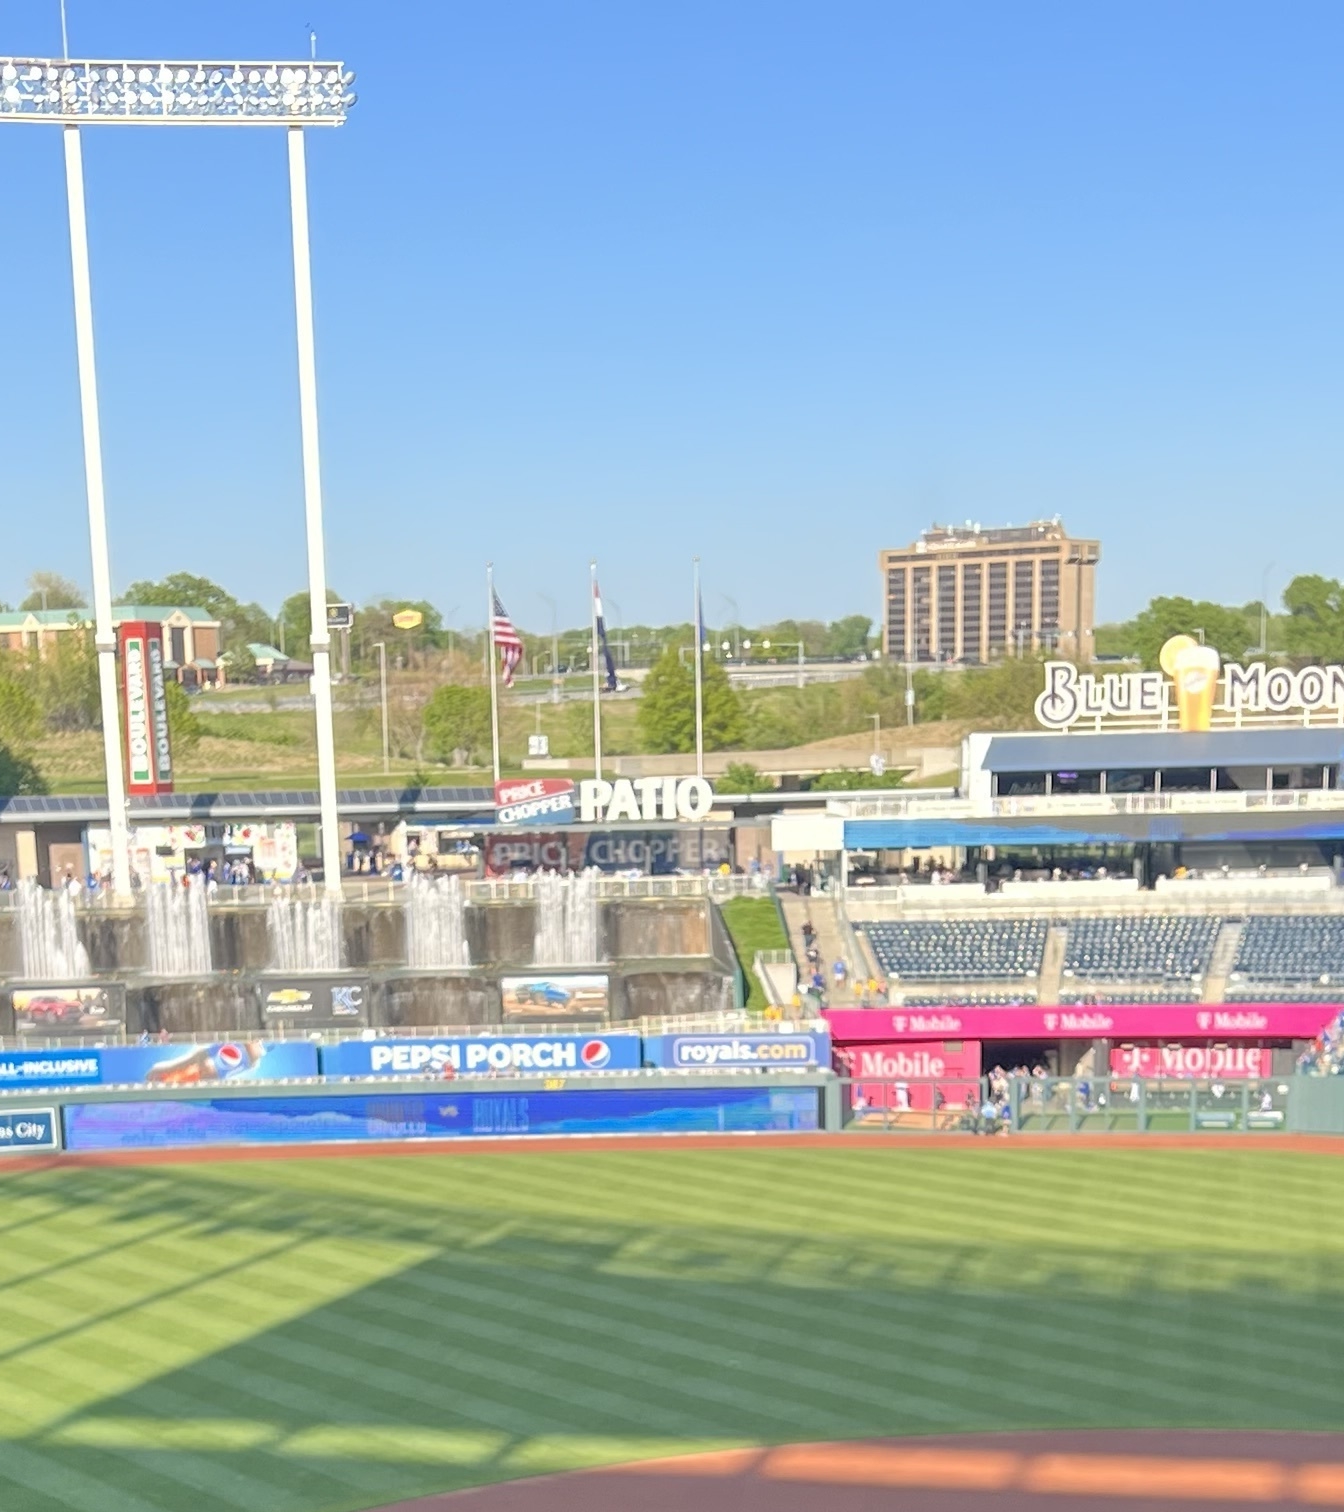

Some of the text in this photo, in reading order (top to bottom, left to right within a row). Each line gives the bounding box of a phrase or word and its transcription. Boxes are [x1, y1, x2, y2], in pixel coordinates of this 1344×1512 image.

[1035, 661, 1164, 728] BLUE
[127, 649, 148, 771] BOULEVARD
[150, 649, 171, 770] BOULEVARD
[499, 780, 546, 804] PRICE
[580, 777, 714, 822] PATIO
[498, 794, 572, 823] CHOPPER
[909, 1014, 962, 1032] Mobile
[1061, 1013, 1113, 1031] Mobile
[1214, 1011, 1268, 1029] Mobile
[370, 1042, 576, 1071] PEPSI PORCH
[680, 1040, 807, 1064] royals.com
[861, 1051, 945, 1077] Mobile
[16, 1121, 46, 1140] City
